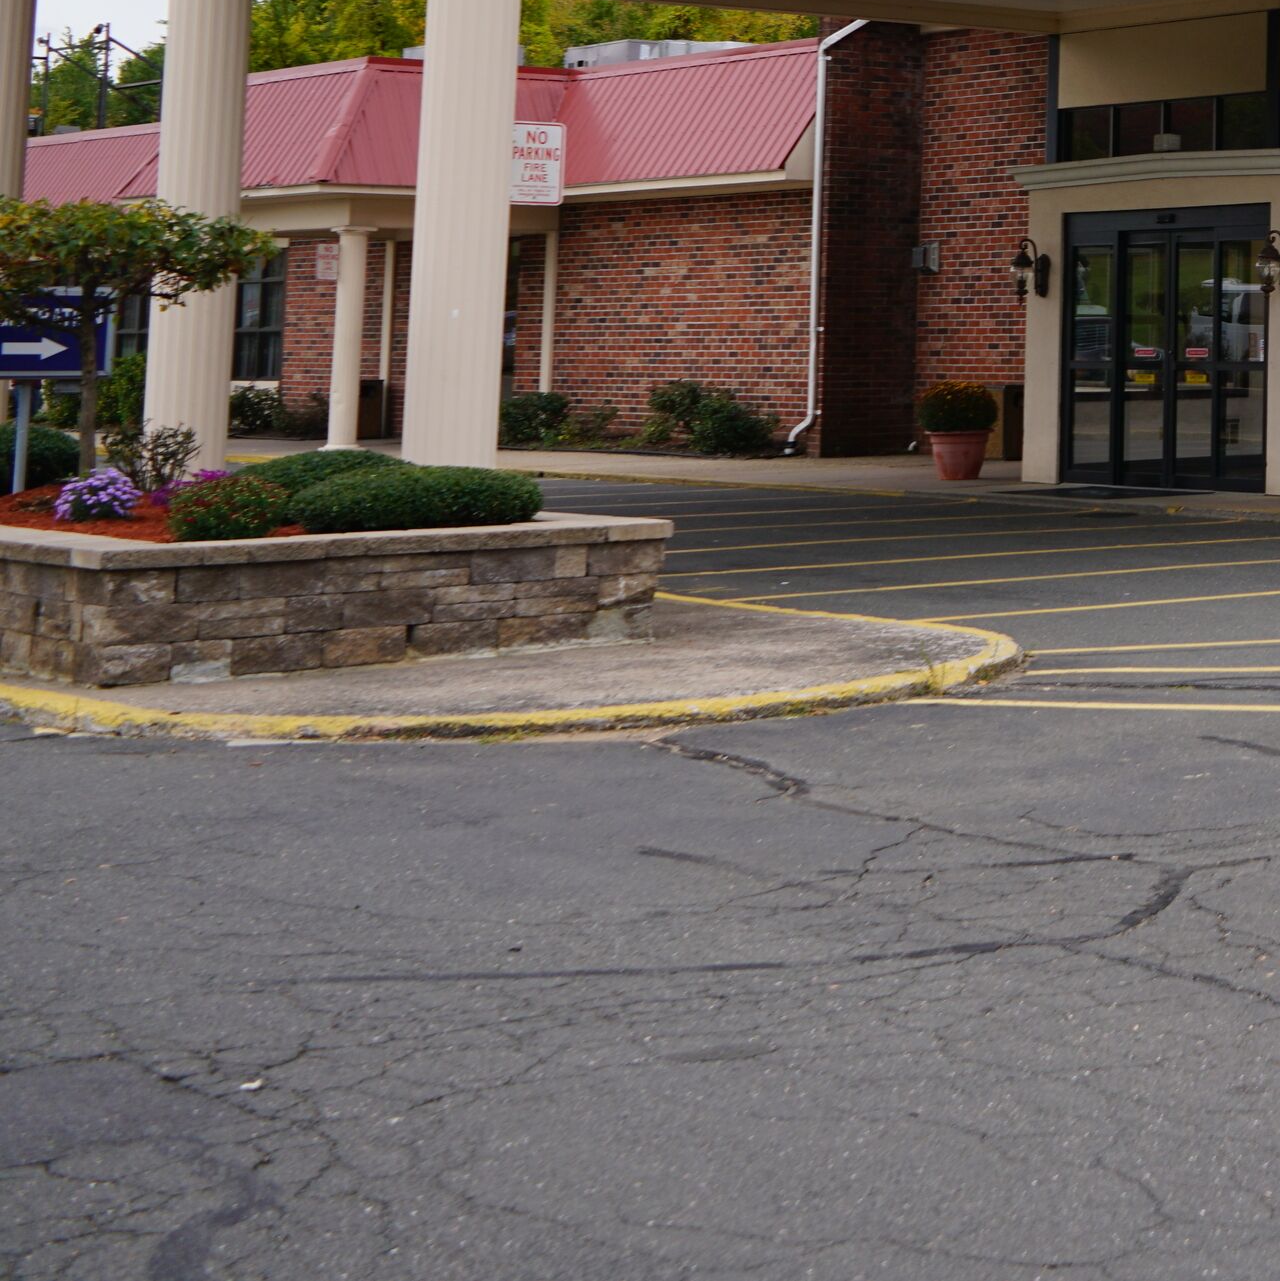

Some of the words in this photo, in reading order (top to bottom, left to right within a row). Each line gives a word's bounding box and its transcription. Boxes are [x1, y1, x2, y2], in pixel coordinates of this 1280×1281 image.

[526, 130, 548, 145] NO
[512, 146, 561, 161] PARKING
[523, 162, 548, 173] FIRE
[521, 173, 549, 183] LANE
